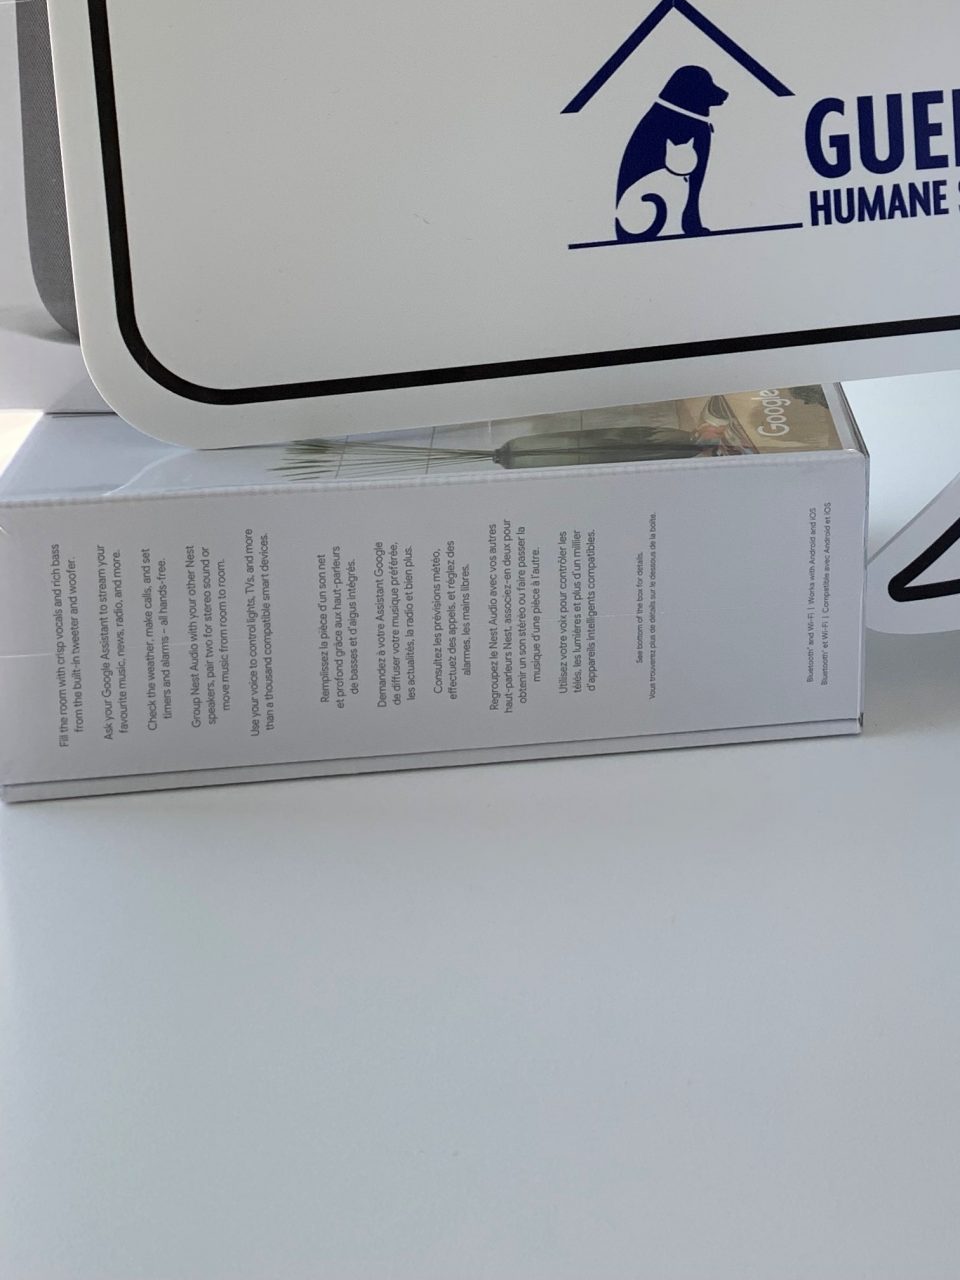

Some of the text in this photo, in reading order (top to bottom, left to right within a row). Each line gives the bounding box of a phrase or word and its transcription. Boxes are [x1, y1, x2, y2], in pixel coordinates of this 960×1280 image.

[809, 179, 949, 227] HUMANE
[752, 389, 791, 437] Google
[156, 558, 168, 614] hands-free.
[259, 533, 270, 572] devices.
[260, 573, 270, 601] smart
[373, 542, 386, 578] Google
[374, 578, 385, 622] Assistant
[635, 552, 644, 664] See bottom of the box for details.
[50, 544, 69, 748] Fill the room with crisp vocals and rich bass
[65, 557, 84, 733] from the built-in tweeter and woofer.
[96, 544, 115, 740] Ask your Google Assistant to stream your
[111, 549, 129, 734] favourite music, news, radio, and more.
[140, 548, 158, 731] Check the weather, make calls, and set
[158, 615, 169, 626] all
[160, 635, 170, 668] alarms
[185, 545, 202, 728] Group Nest Audio with your other Nest
[199, 546, 218, 725] speakers, pair two for stereo sound or
[217, 558, 231, 711] move music from room to room.
[244, 528, 260, 737] Use your voice to control lights, TVs, and more
[260, 602, 274, 656] compatible
[316, 554, 332, 703] Remplissez la pièce d'un son net
[331, 546, 347, 709] et profond grâce aux haut-parleurs
[345, 559, 359, 695] de basses et d'aigus intégrés.
[376, 623, 386, 649] votre
[387, 542, 402, 706] de diffuser votre musique préférée,
[402, 545, 416, 701] les actualités, la radio et bien plus.
[430, 548, 444, 694] Consultez les prévisions météo,
[444, 540, 458, 700] effectuez des appels, et réglez des
[460, 564, 472, 676] alarmes, les mains libres.
[160, 669, 171, 688] and
[162, 688, 172, 719] timers
[262, 656, 274, 701] thousand
[265, 709, 275, 731] than
[376, 657, 387, 708] Demandez
